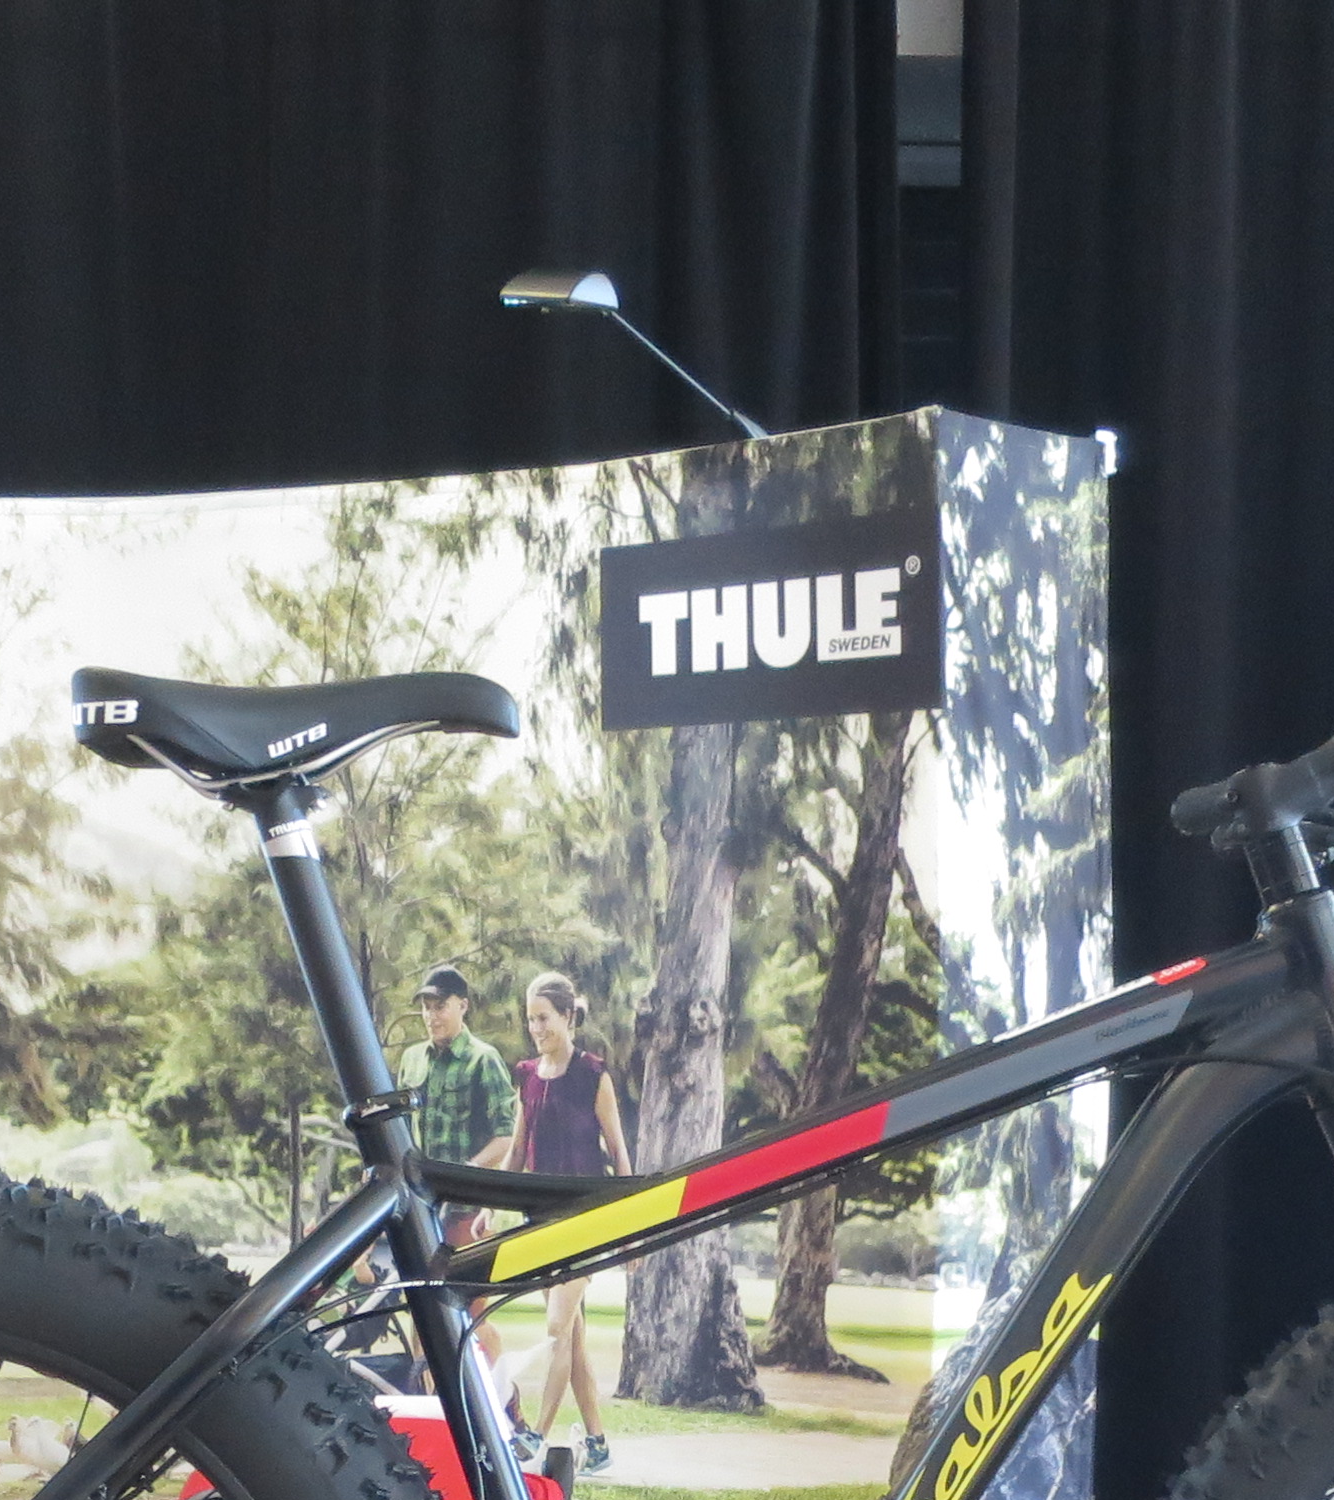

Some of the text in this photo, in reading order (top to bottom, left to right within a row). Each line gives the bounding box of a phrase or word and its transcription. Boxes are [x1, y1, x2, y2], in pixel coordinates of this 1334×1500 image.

[639, 567, 902, 676] THULE
[828, 633, 891, 654] SWEDEN
[267, 722, 329, 759] WTB
